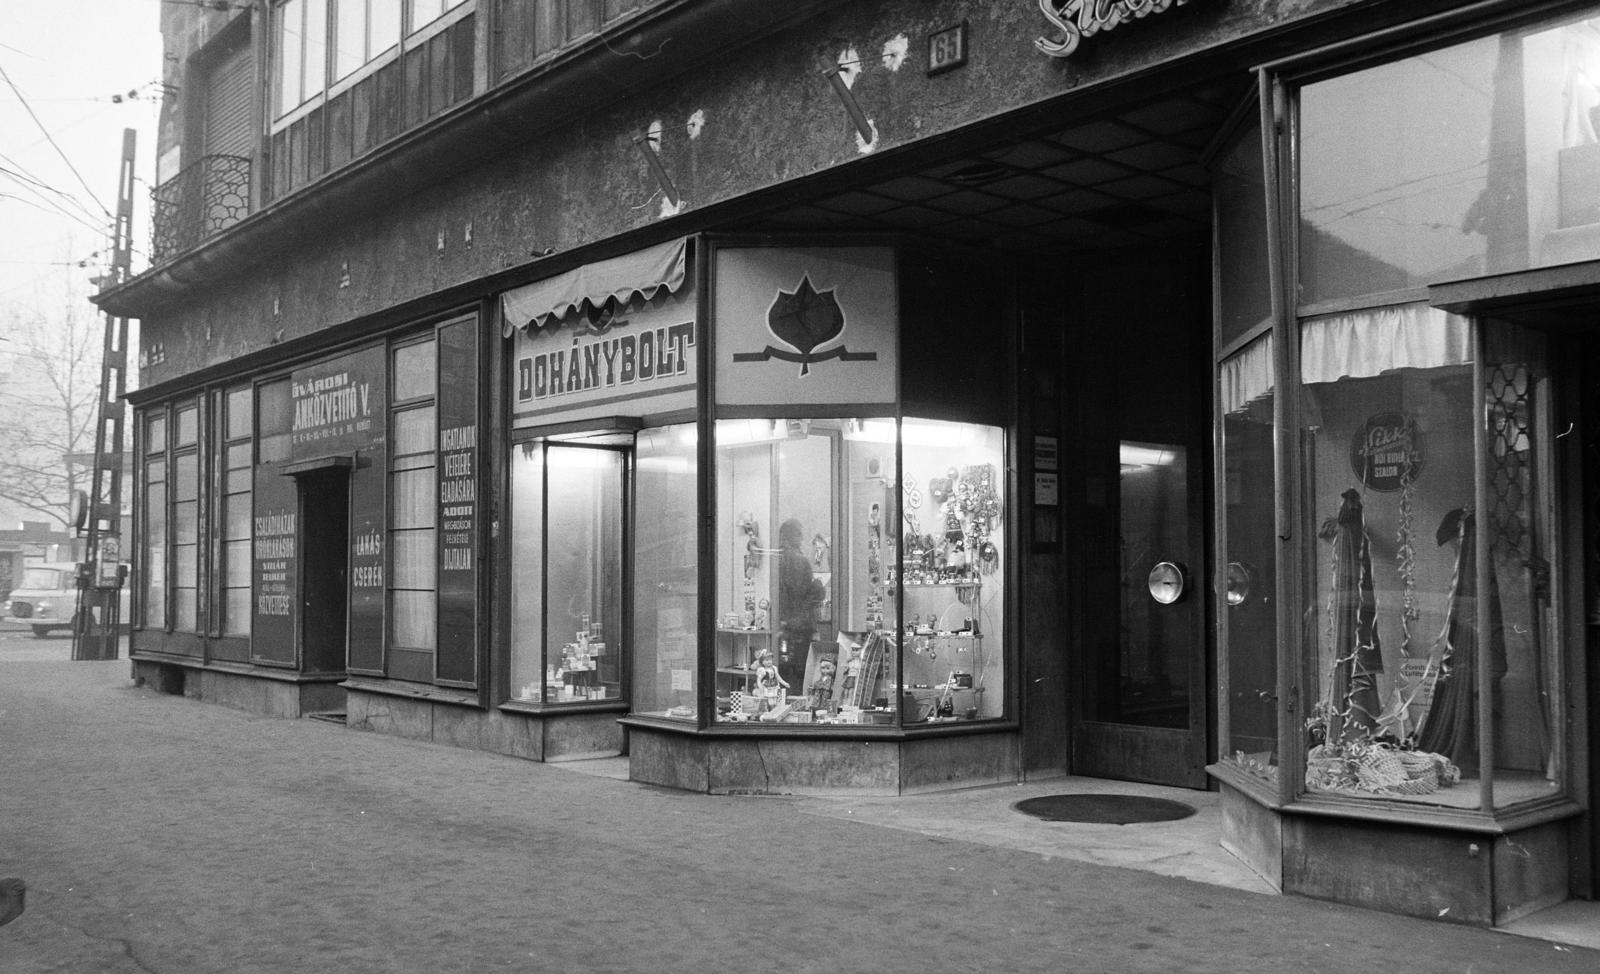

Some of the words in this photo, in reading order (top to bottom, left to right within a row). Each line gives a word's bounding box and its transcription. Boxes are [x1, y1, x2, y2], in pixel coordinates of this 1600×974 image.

[934, 34, 957, 65] 65
[519, 321, 696, 403] DOHÁNYBOLT
[440, 425, 476, 452] INGATLANOK
[444, 450, 471, 477] VÉTELÉRE
[441, 476, 475, 503] ELADÁSÁRA
[443, 505, 473, 517] ADOTT
[356, 527, 381, 556] LAKÁS
[353, 561, 383, 587] CSERÉK
